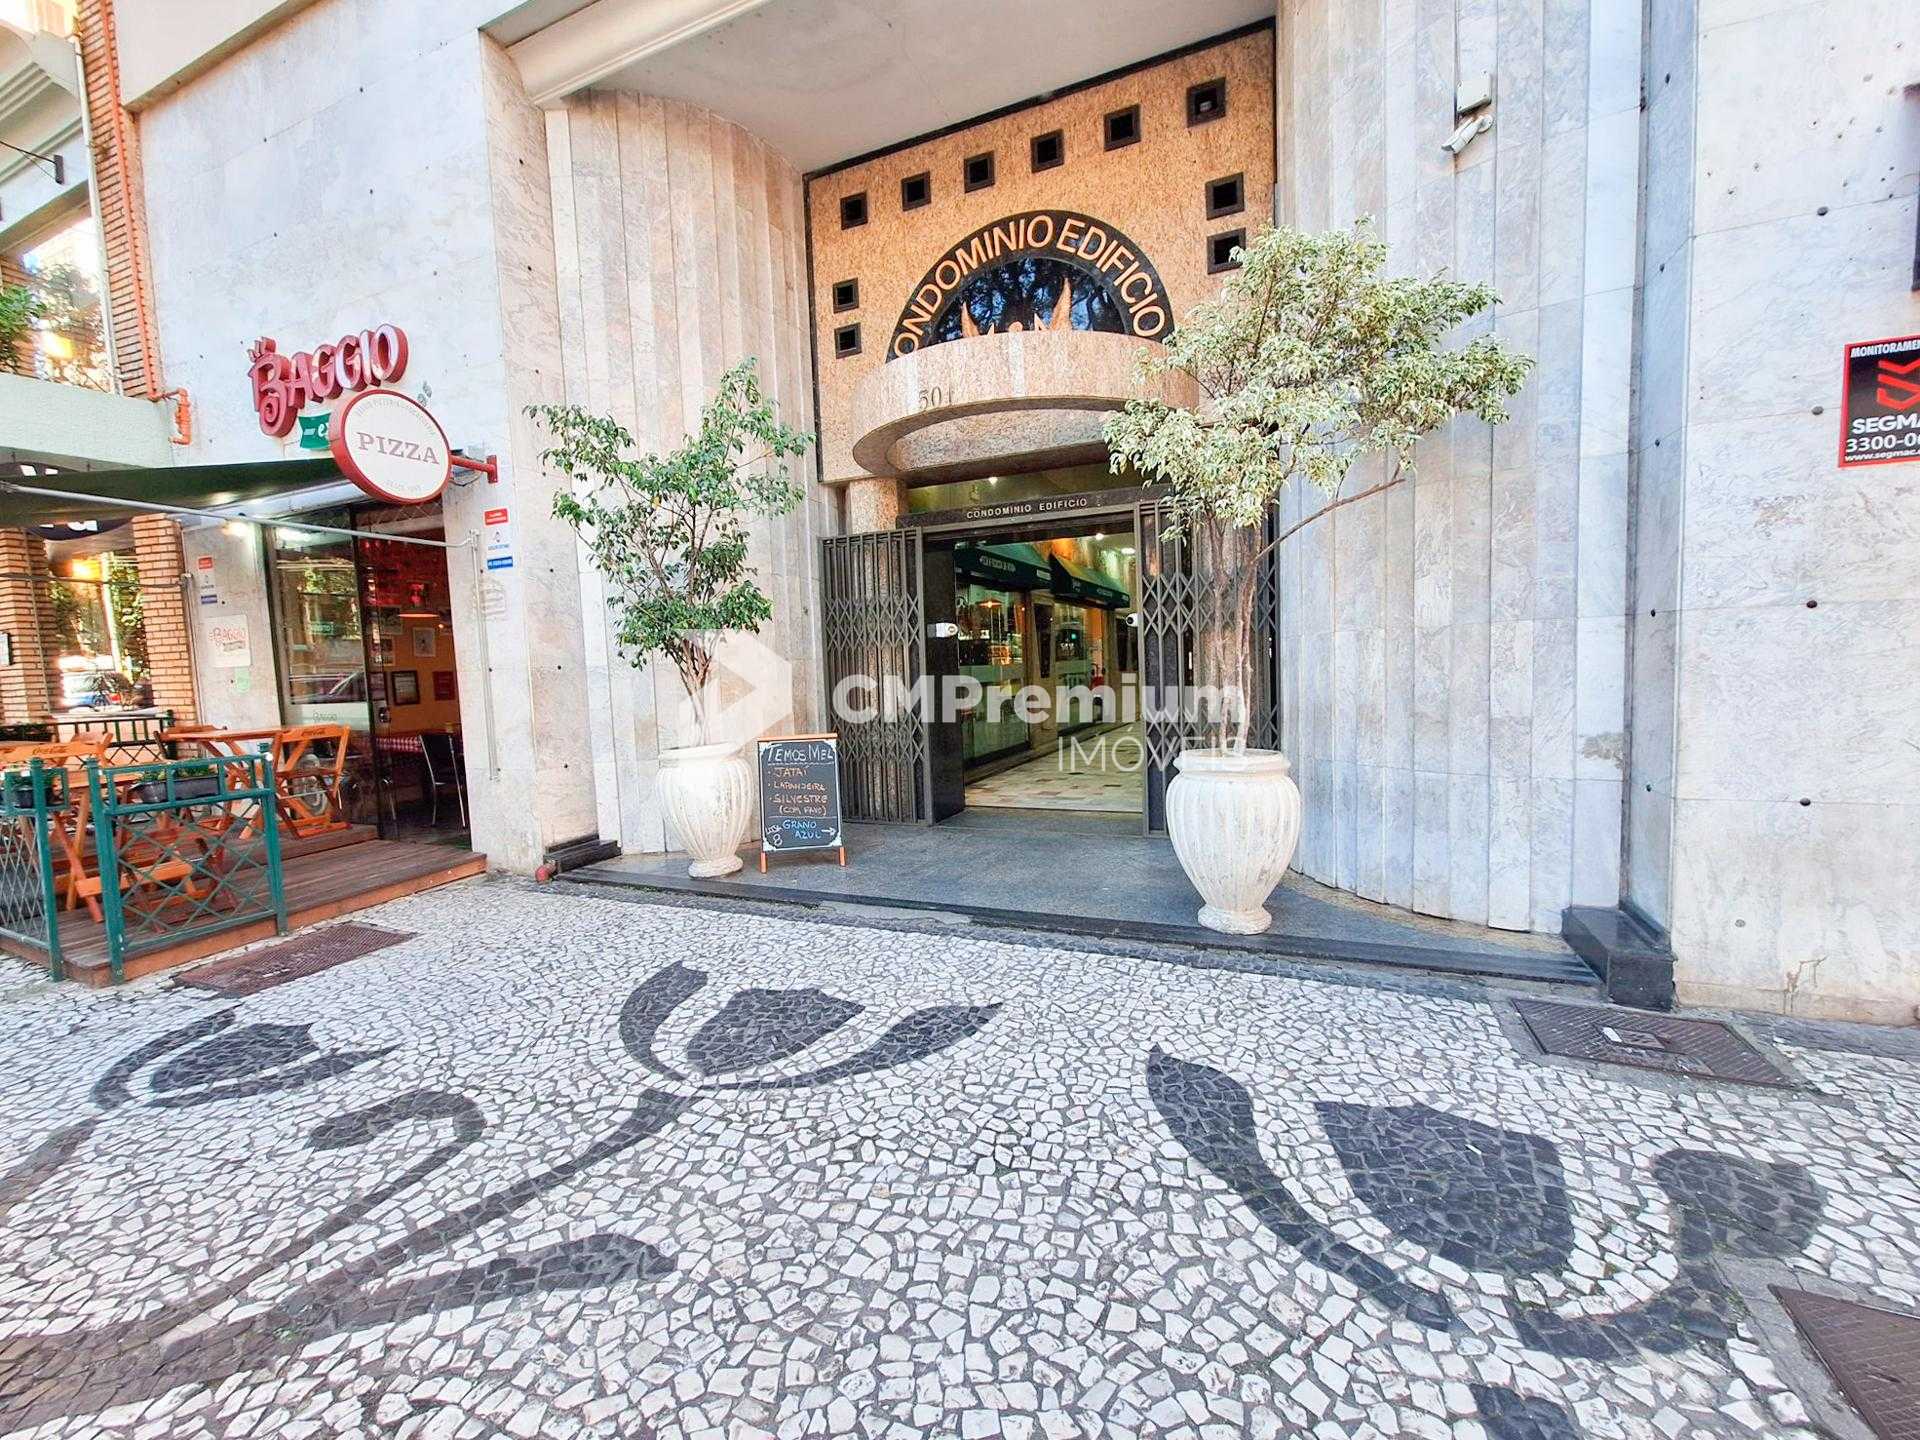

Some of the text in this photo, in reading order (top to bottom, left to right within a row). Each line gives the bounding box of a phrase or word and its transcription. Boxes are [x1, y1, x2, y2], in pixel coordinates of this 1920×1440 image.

[894, 214, 1166, 358] ONDOMINIO EDIFICIO
[249, 323, 409, 438] BAGGIO
[356, 431, 441, 465] PIZZA
[768, 743, 834, 762] TEMOS MEL
